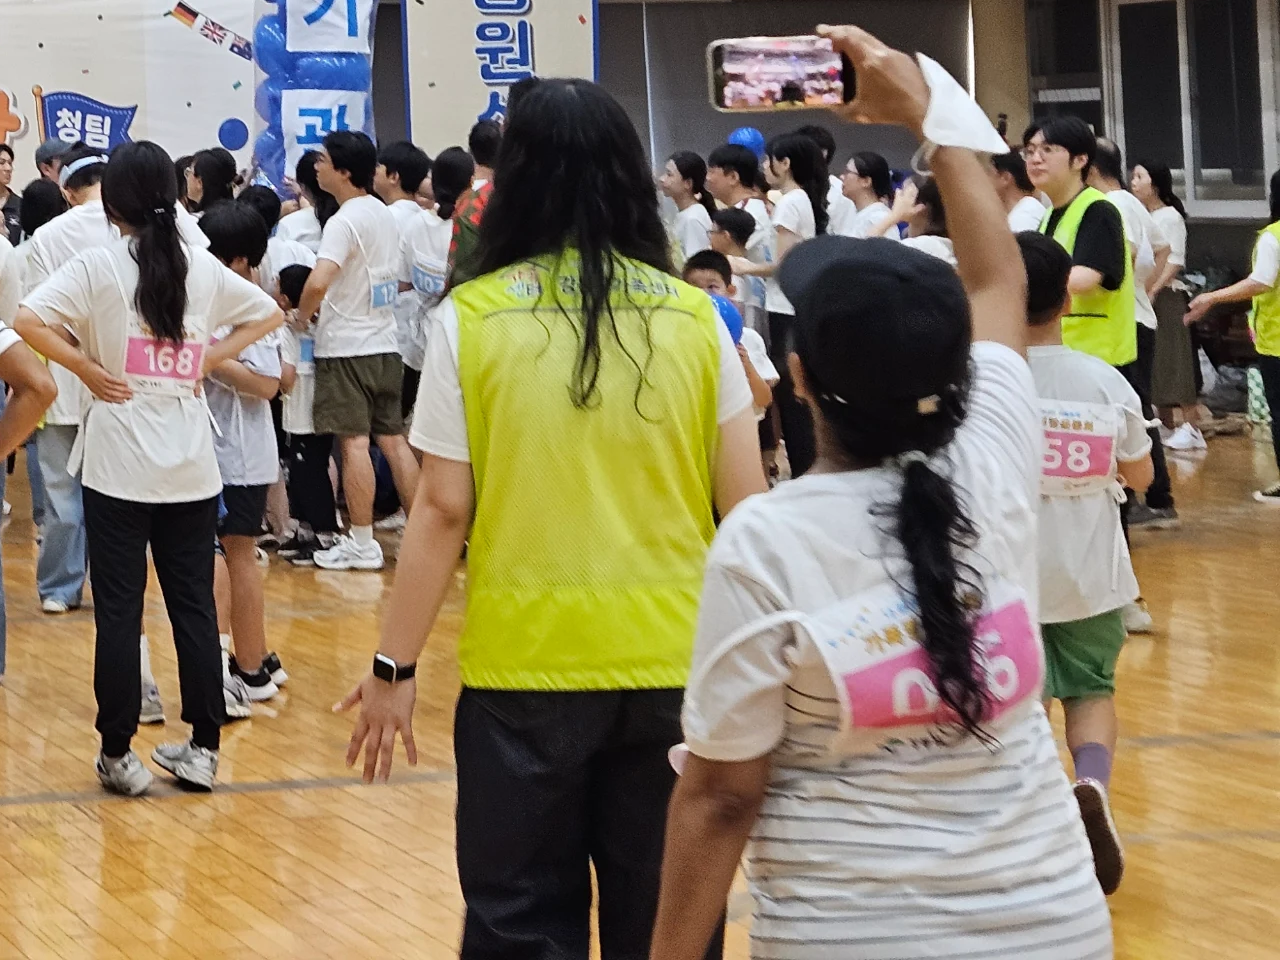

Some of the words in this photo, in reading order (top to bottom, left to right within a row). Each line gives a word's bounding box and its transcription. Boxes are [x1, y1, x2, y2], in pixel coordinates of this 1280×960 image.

[55, 107, 112, 149] 청팀
[143, 343, 195, 376] 168
[1041, 438, 1091, 473] 58
[891, 631, 1019, 718] 06
